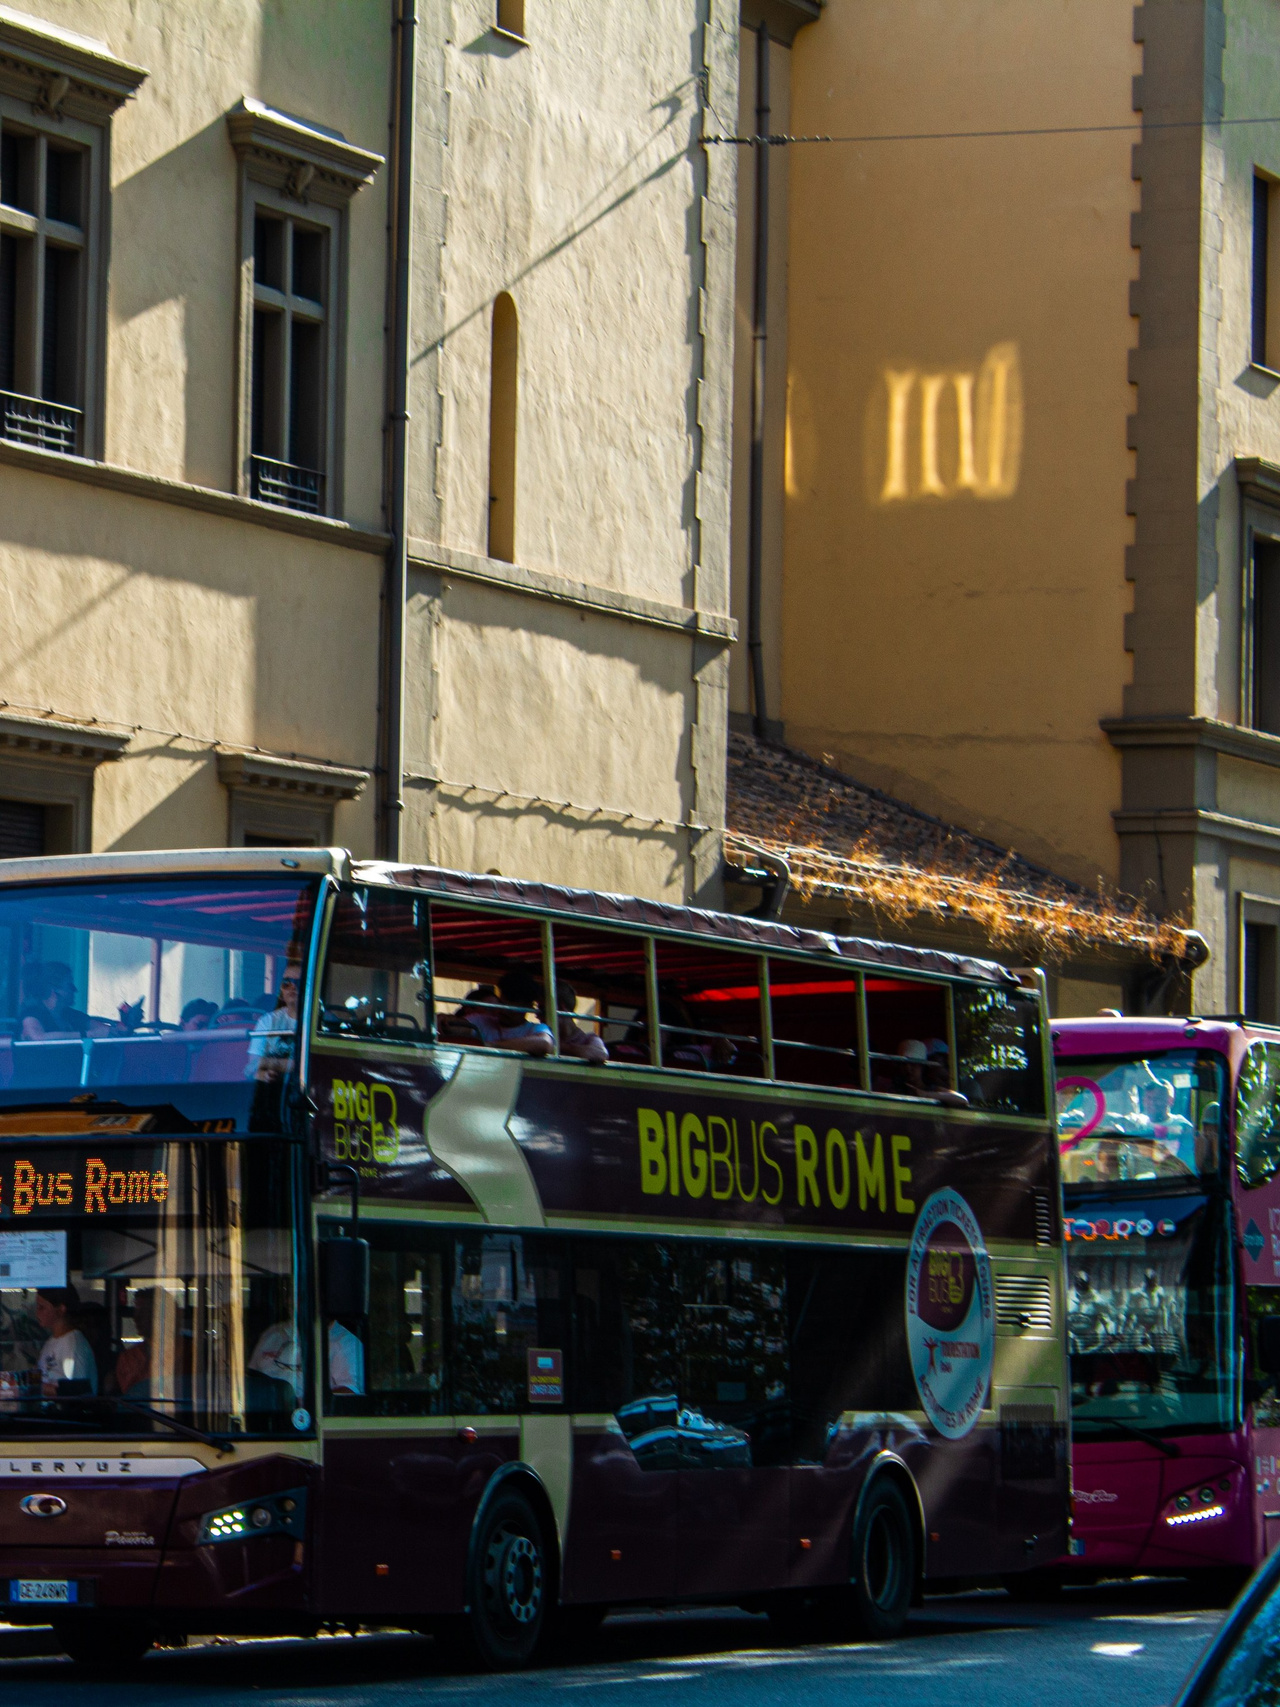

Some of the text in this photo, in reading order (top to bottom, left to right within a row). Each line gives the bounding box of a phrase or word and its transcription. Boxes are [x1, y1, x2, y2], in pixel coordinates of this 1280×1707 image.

[332, 1078, 369, 1122] BIG
[334, 1122, 372, 1163] BUS
[13, 1160, 74, 1215] Bus
[84, 1158, 170, 1213] Rome
[795, 1124, 917, 1214] ROME
